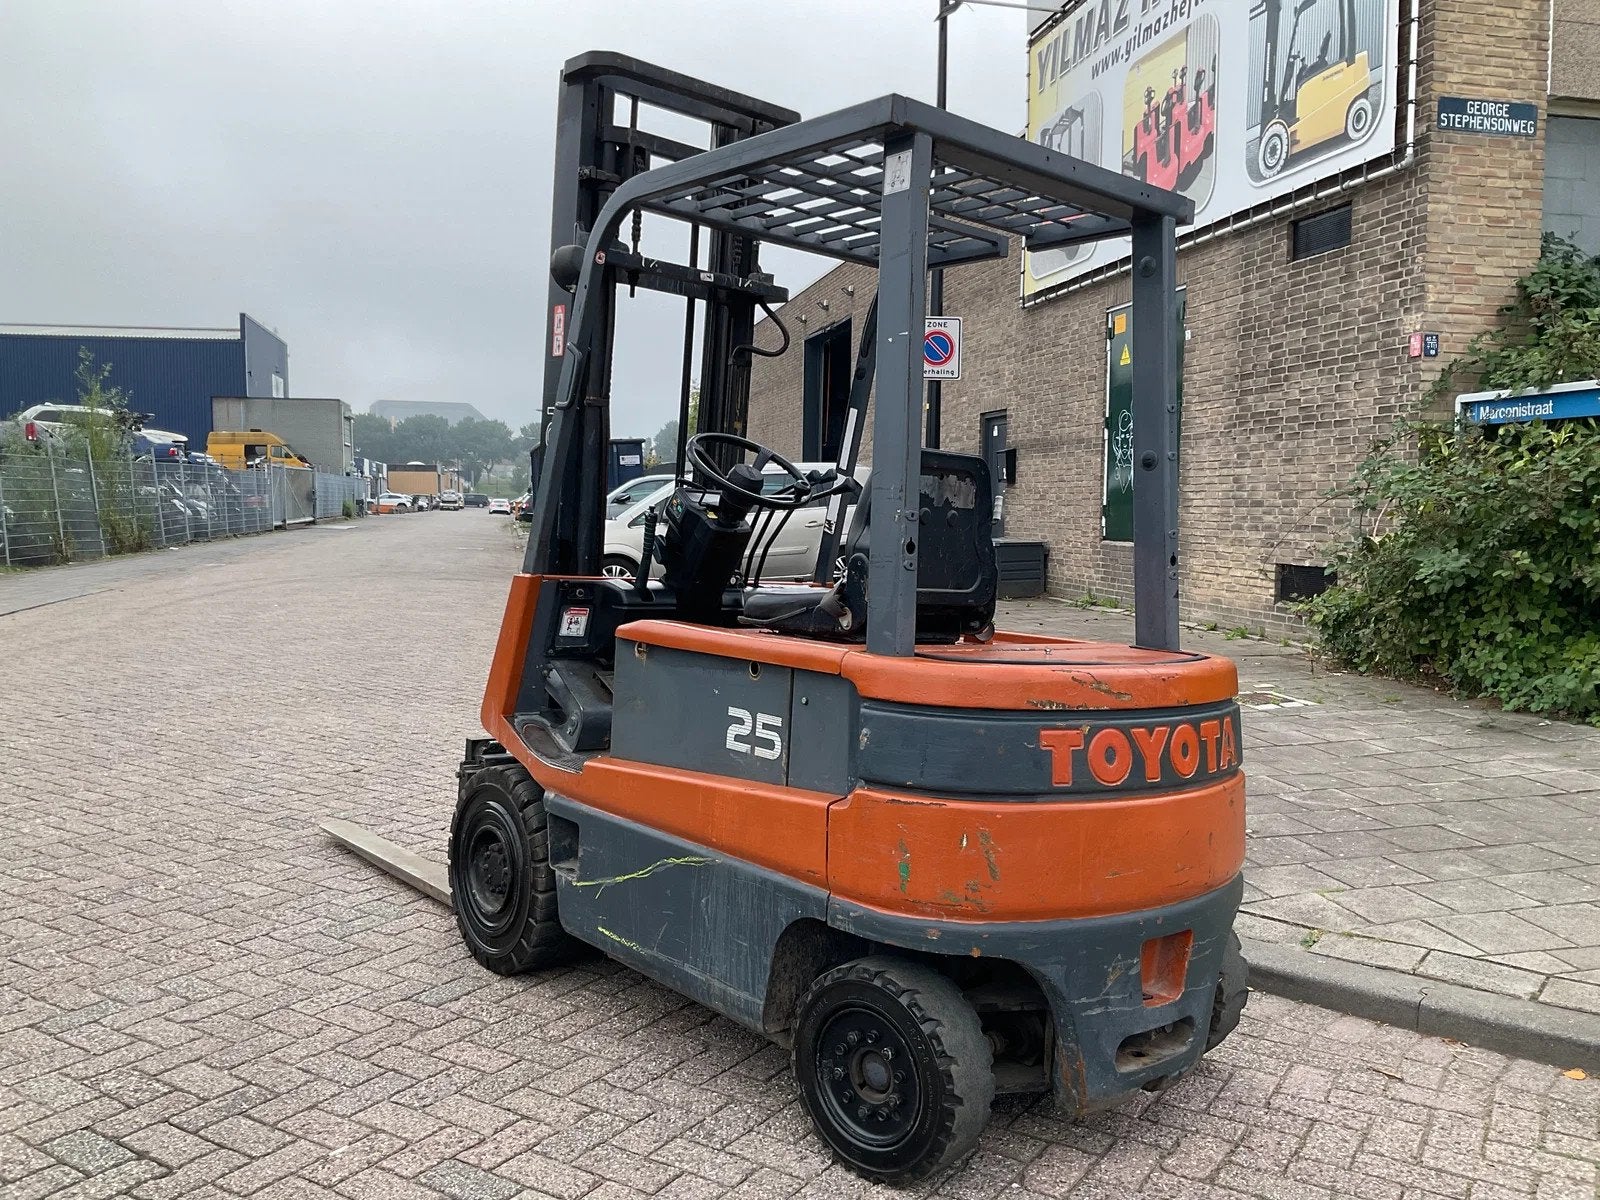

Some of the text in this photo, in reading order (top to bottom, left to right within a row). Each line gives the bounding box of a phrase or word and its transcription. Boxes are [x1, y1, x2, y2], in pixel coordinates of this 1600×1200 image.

[1037, 0, 1130, 93] YILMAZ
[1440, 113, 1535, 134] STEPHENSONWEG
[1467, 101, 1510, 117] GEORGE
[1479, 399, 1554, 420] Marconistraat
[726, 706, 782, 760] 25
[1039, 716, 1236, 787] TOYOTA
